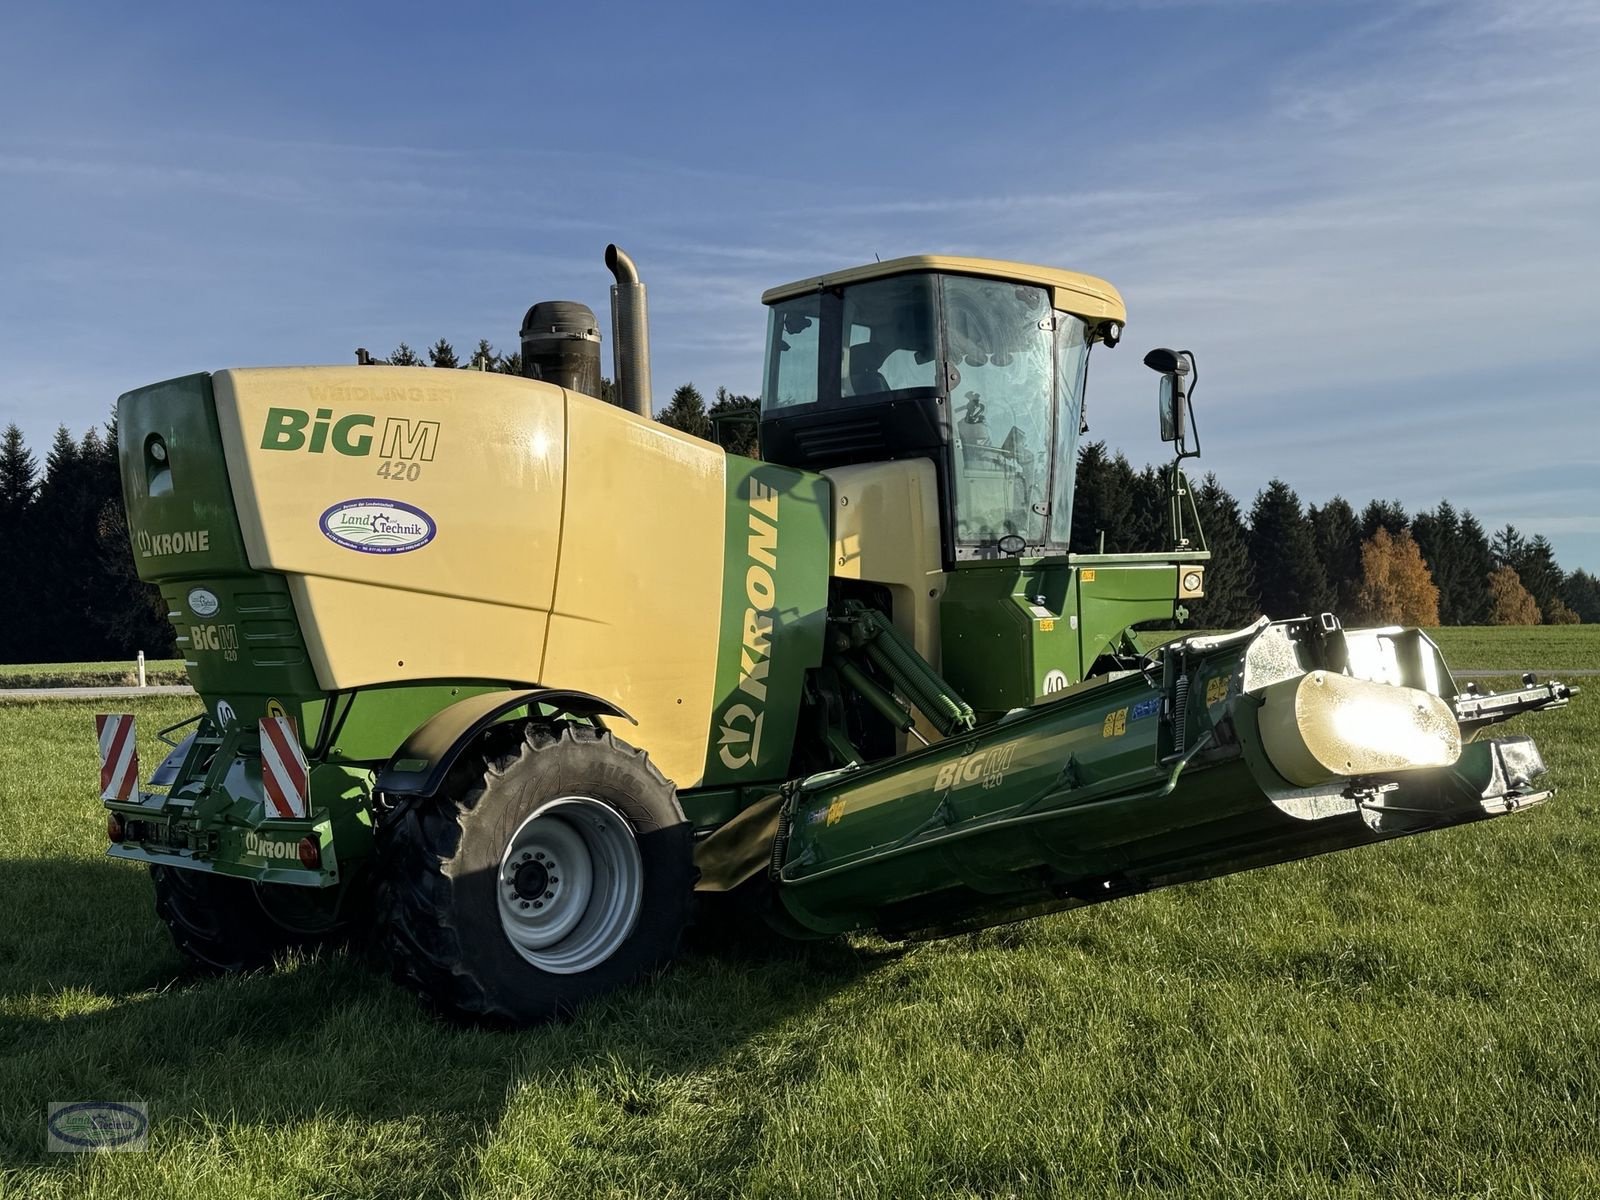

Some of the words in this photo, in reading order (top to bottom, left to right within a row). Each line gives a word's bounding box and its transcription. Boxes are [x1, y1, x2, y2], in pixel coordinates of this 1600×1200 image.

[260, 407, 376, 457] BiG
[379, 417, 441, 462] M
[377, 461, 421, 482] 420
[341, 513, 370, 526] Land
[380, 522, 422, 535] Technik
[152, 530, 209, 555] KRONE
[739, 476, 778, 702] KRONE
[190, 625, 219, 651] BiG
[224, 650, 238, 662] 420
[934, 752, 986, 792] BiG
[982, 772, 1003, 790] 420
